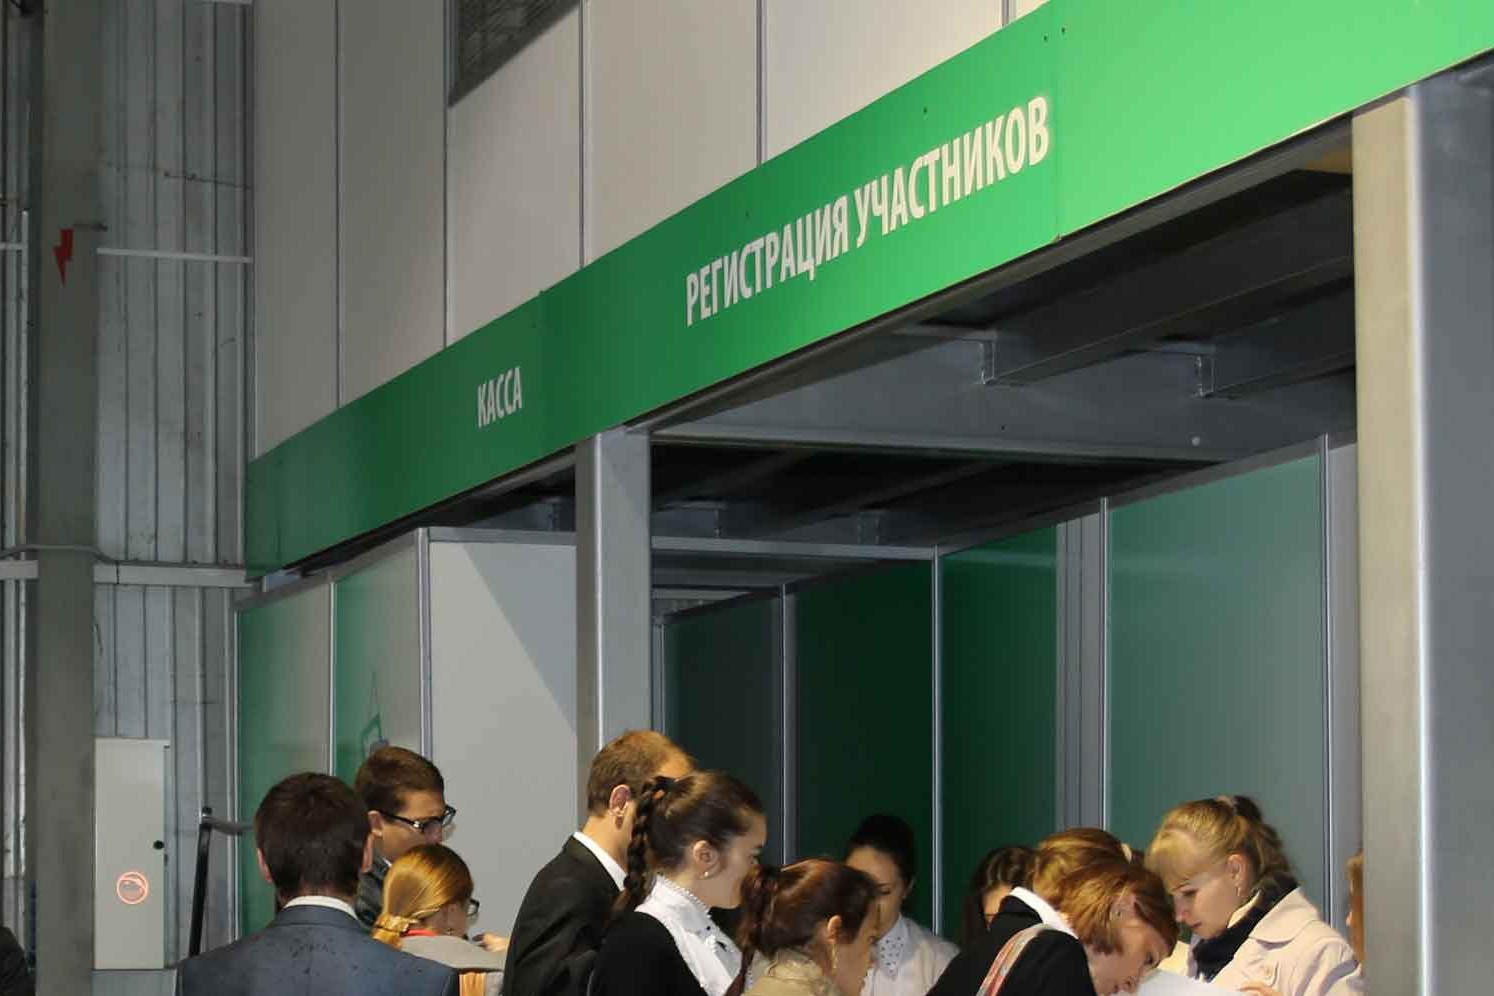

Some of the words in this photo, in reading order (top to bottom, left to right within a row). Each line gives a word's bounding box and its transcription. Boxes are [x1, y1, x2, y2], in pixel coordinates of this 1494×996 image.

[686, 195, 848, 326] РЕГИСТРАЦИЯ
[854, 95, 1052, 247] УЧАСТНИКОВ
[476, 366, 523, 427] КАССА
